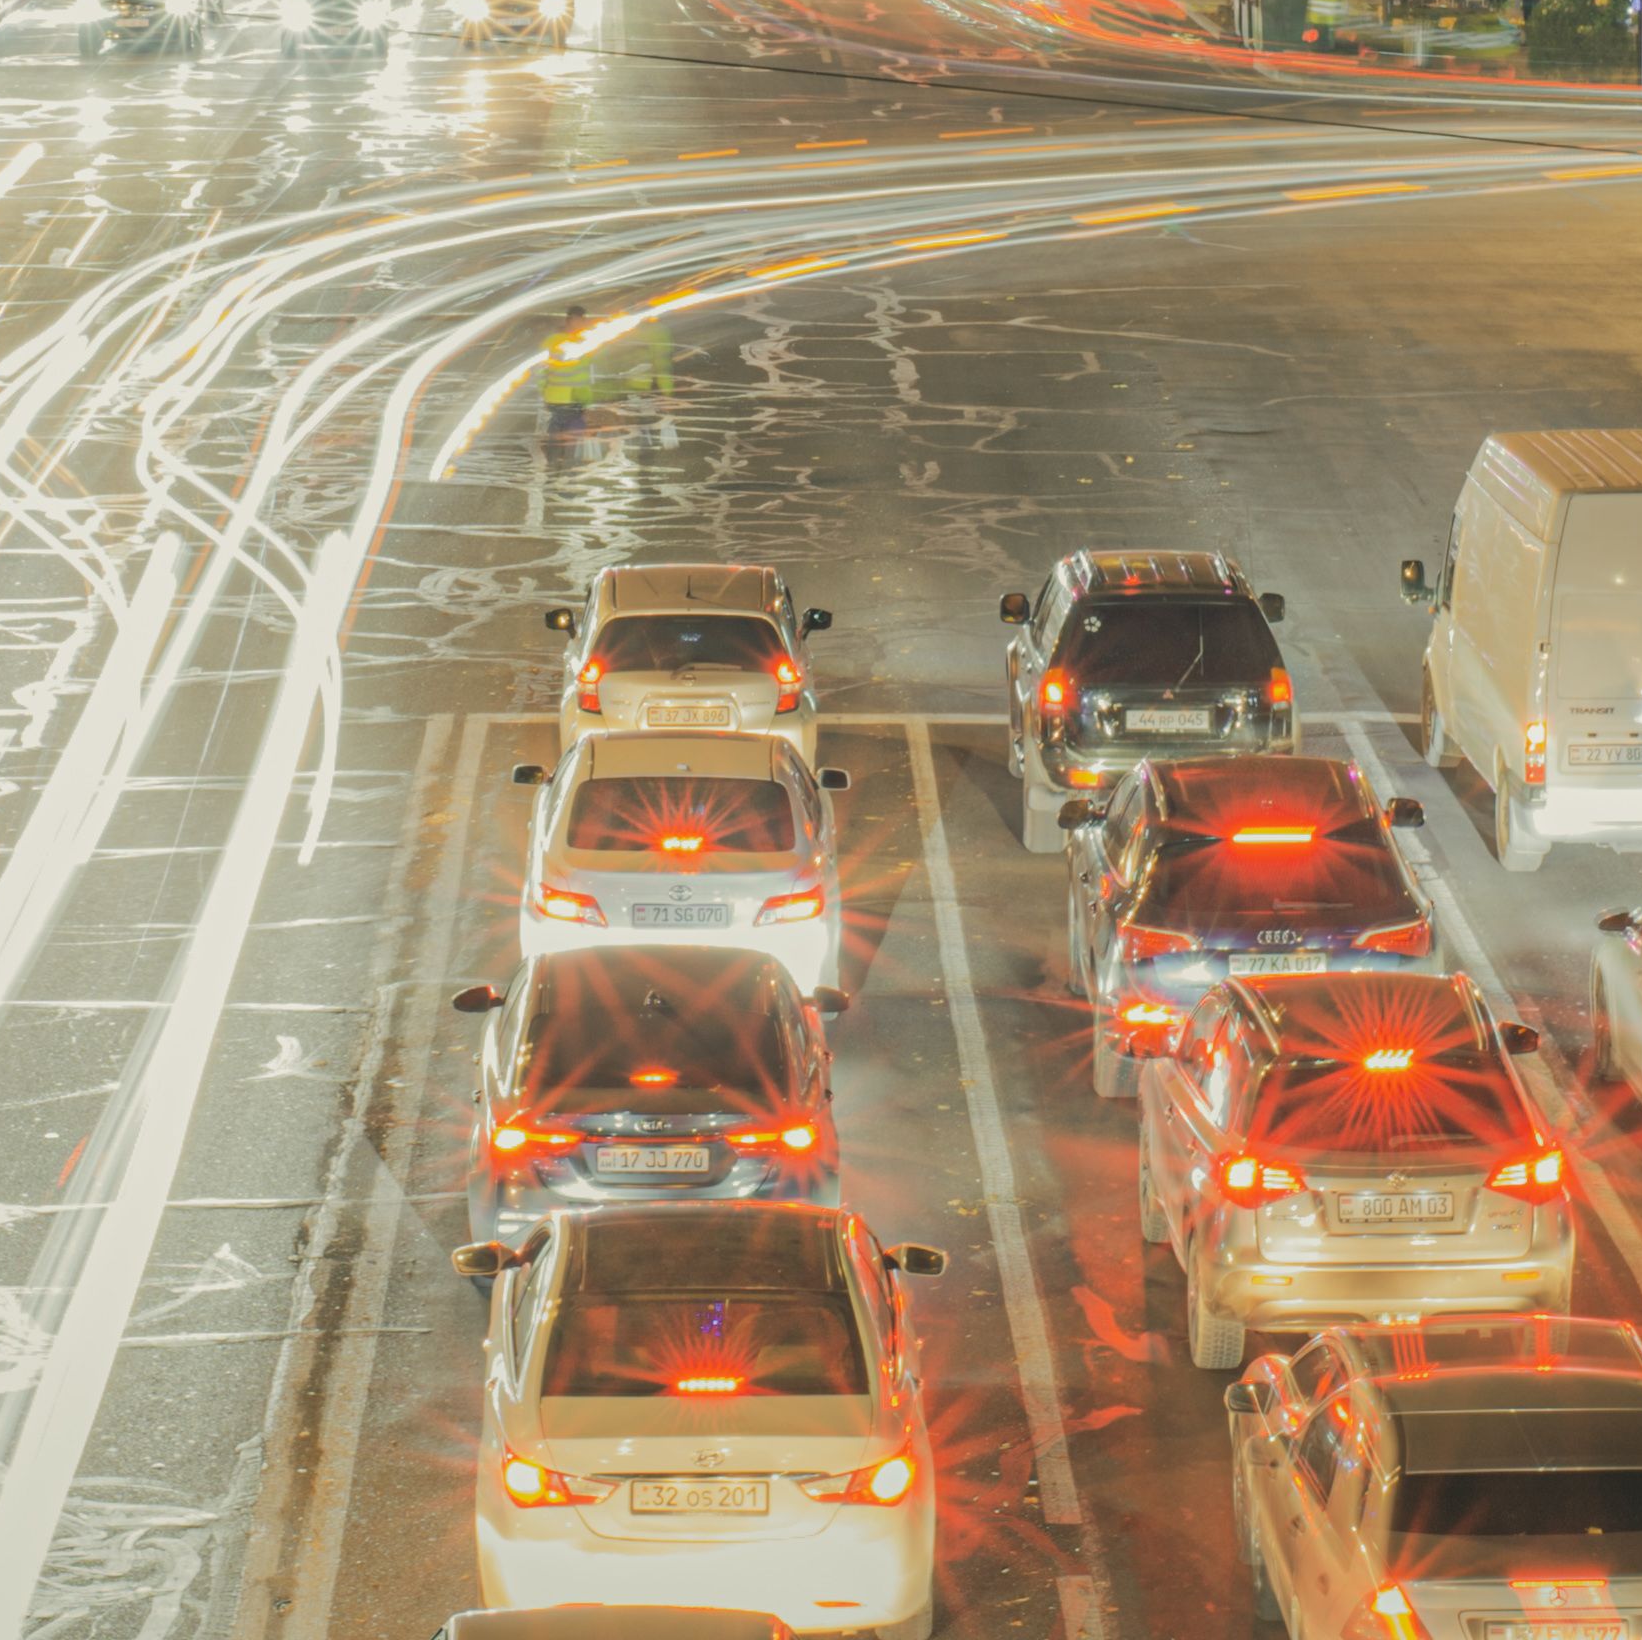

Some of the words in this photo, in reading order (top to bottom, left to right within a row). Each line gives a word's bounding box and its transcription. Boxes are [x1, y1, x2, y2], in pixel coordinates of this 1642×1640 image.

[665, 710, 679, 722] 37
[1569, 707, 1615, 715] TRANSIT
[1138, 713, 1155, 726] 44
[1178, 713, 1204, 726] 045
[1587, 748, 1602, 761] 22
[1604, 748, 1622, 761] YY
[653, 907, 669, 922] 71
[674, 907, 694, 922] SG
[697, 907, 723, 922] 070
[1249, 957, 1266, 971] 77
[1270, 956, 1291, 971] KA
[1295, 956, 1322, 971] 017
[642, 1120, 663, 1131] KIA
[620, 1151, 641, 1168] 17
[645, 1151, 668, 1168] JJ
[673, 1151, 703, 1168] 770
[1363, 1198, 1393, 1216] 800
[1399, 1197, 1422, 1215] AM
[1427, 1196, 1448, 1215] 03
[652, 1486, 678, 1507] 32
[719, 1486, 758, 1507] 201
